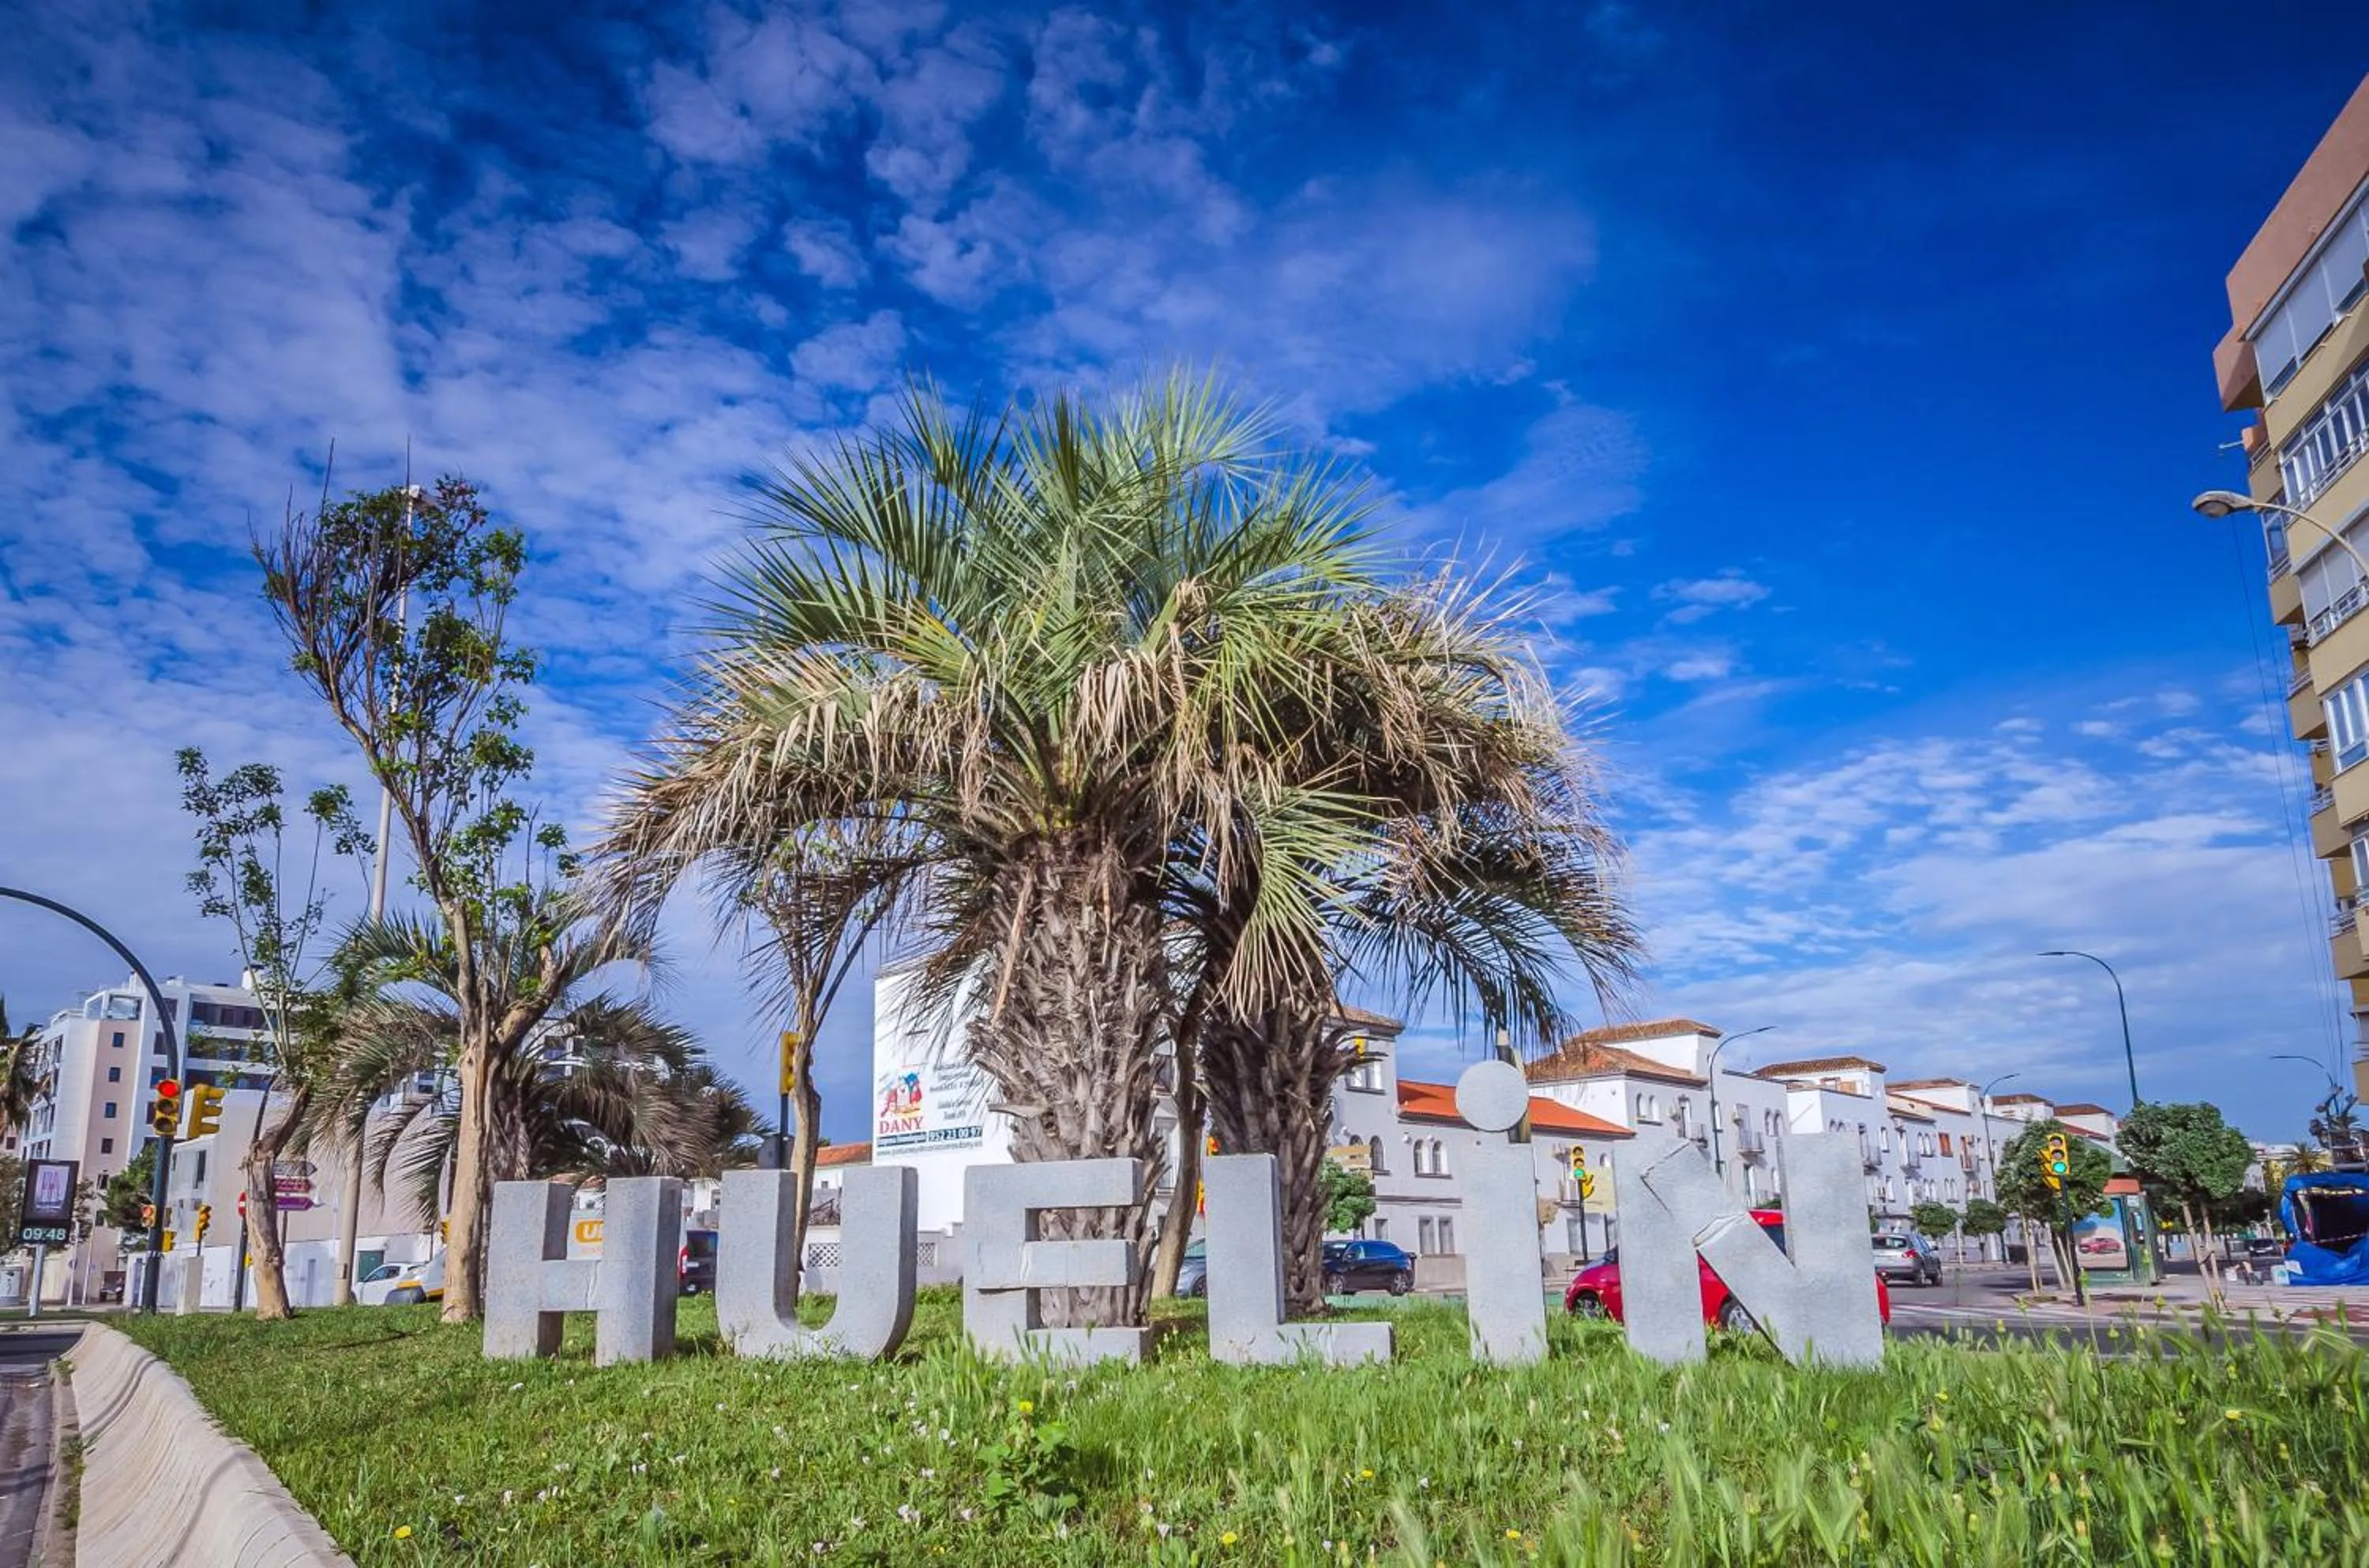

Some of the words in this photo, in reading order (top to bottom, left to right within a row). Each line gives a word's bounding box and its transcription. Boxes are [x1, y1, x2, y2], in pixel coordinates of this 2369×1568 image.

[879, 1116, 923, 1134] DANY
[958, 1127, 968, 1138] 00
[23, 1228, 66, 1240] 09:48
